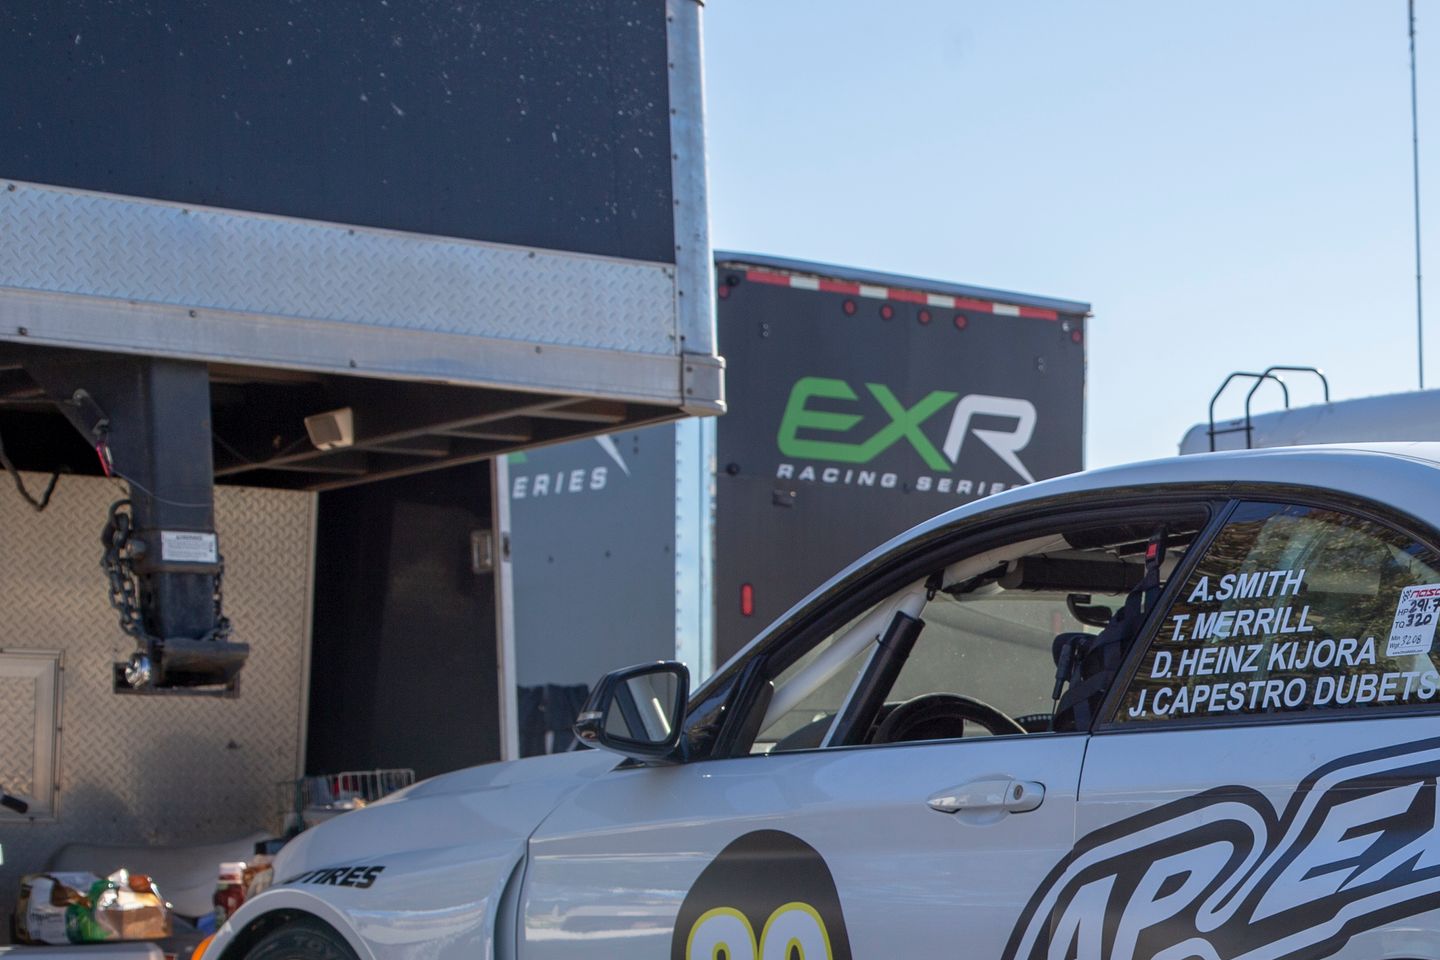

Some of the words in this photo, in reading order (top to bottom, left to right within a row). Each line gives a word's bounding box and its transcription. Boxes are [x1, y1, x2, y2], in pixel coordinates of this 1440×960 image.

[777, 376, 1037, 484] EXR
[777, 463, 898, 489] RACING
[915, 476, 1021, 496] SERIE
[1191, 604, 1313, 641] MERRILL
[1394, 620, 1405, 629] TQ
[1405, 612, 1433, 627] 320
[1267, 636, 1377, 671] KIJORA
[1312, 670, 1440, 706] DUBETS
[301, 866, 386, 889] TIRES
